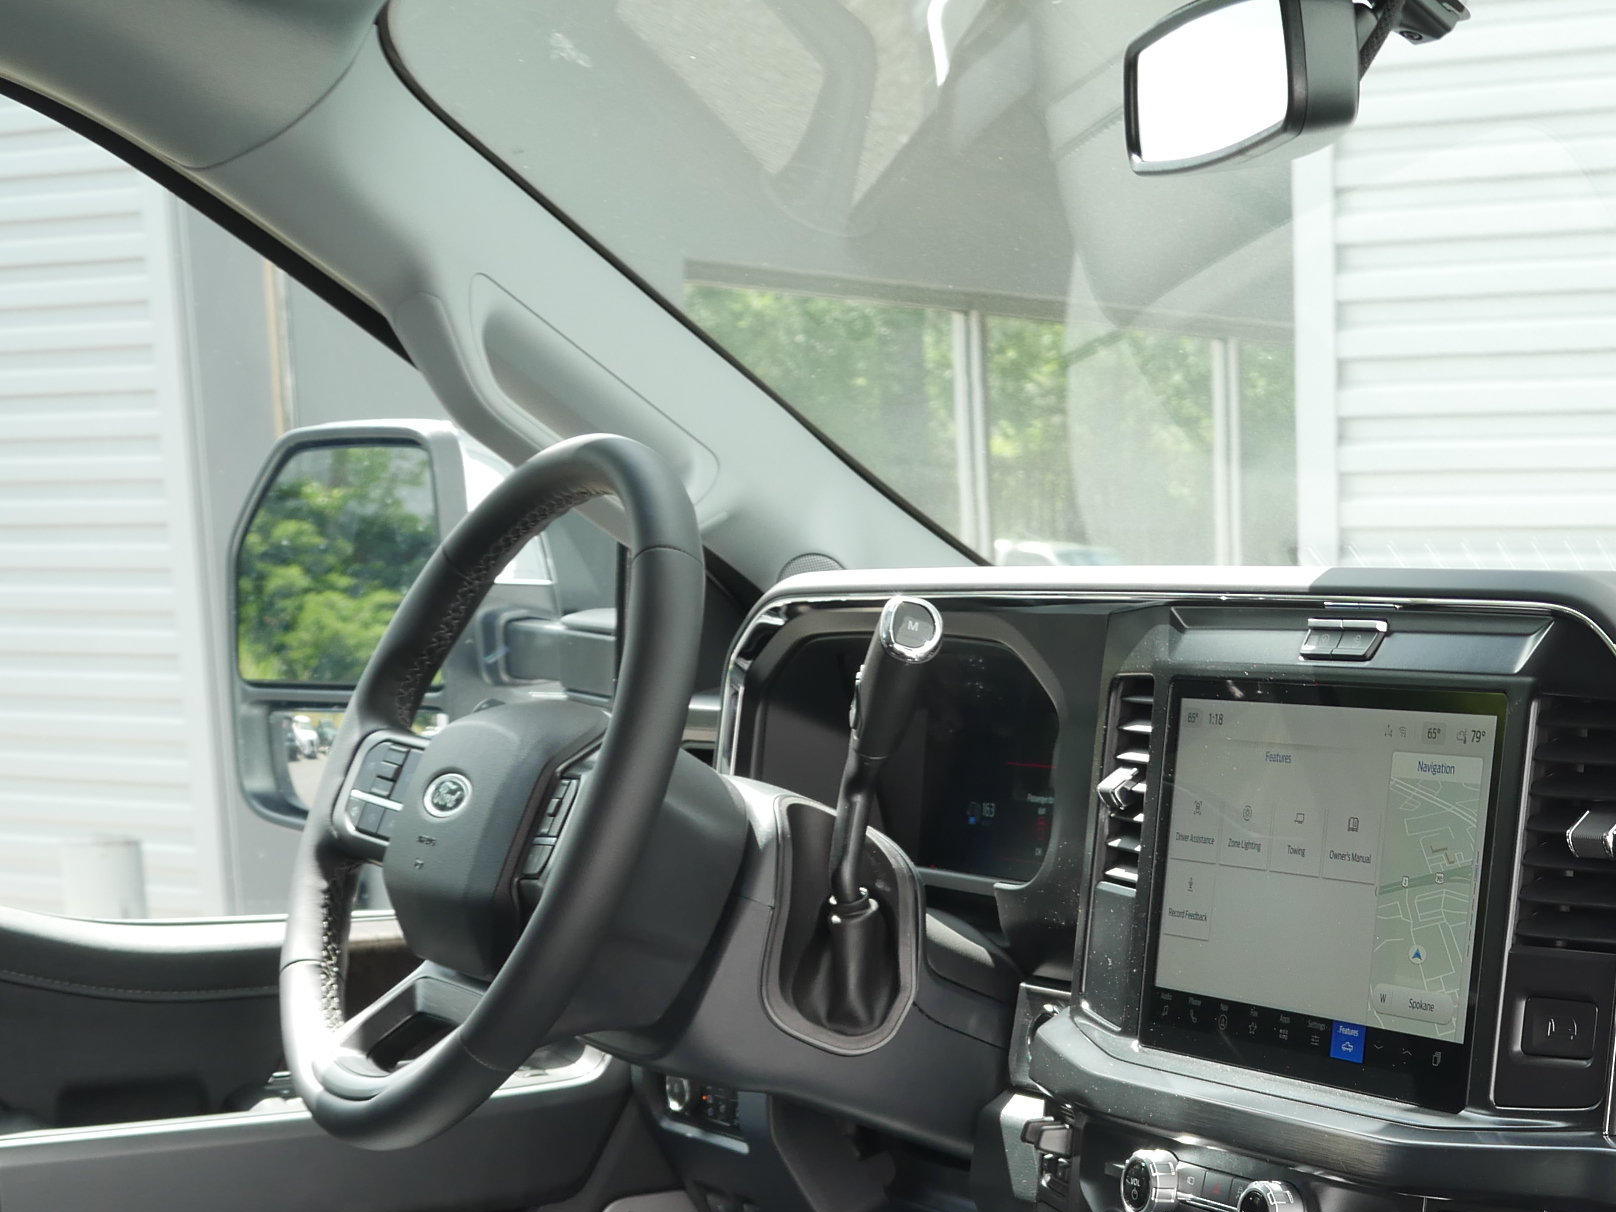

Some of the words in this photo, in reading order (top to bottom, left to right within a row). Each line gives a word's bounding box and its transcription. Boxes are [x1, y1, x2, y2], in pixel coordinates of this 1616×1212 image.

[1208, 713, 1224, 726] 1:18
[1265, 751, 1293, 764] Features
[1417, 760, 1456, 775] Navigation
[1227, 838, 1240, 848] Zone
[1240, 840, 1261, 852] Lighting
[1287, 845, 1305, 857] Towing
[1329, 850, 1350, 862] Owner's
[1351, 852, 1372, 864] Manual
[1168, 908, 1185, 919] Record
[1185, 909, 1208, 922] Feedback
[1380, 993, 1387, 1003] W
[1408, 998, 1434, 1012] Spokane
[1338, 1026, 1359, 1037] Features
[1130, 1176, 1141, 1187] VOL
